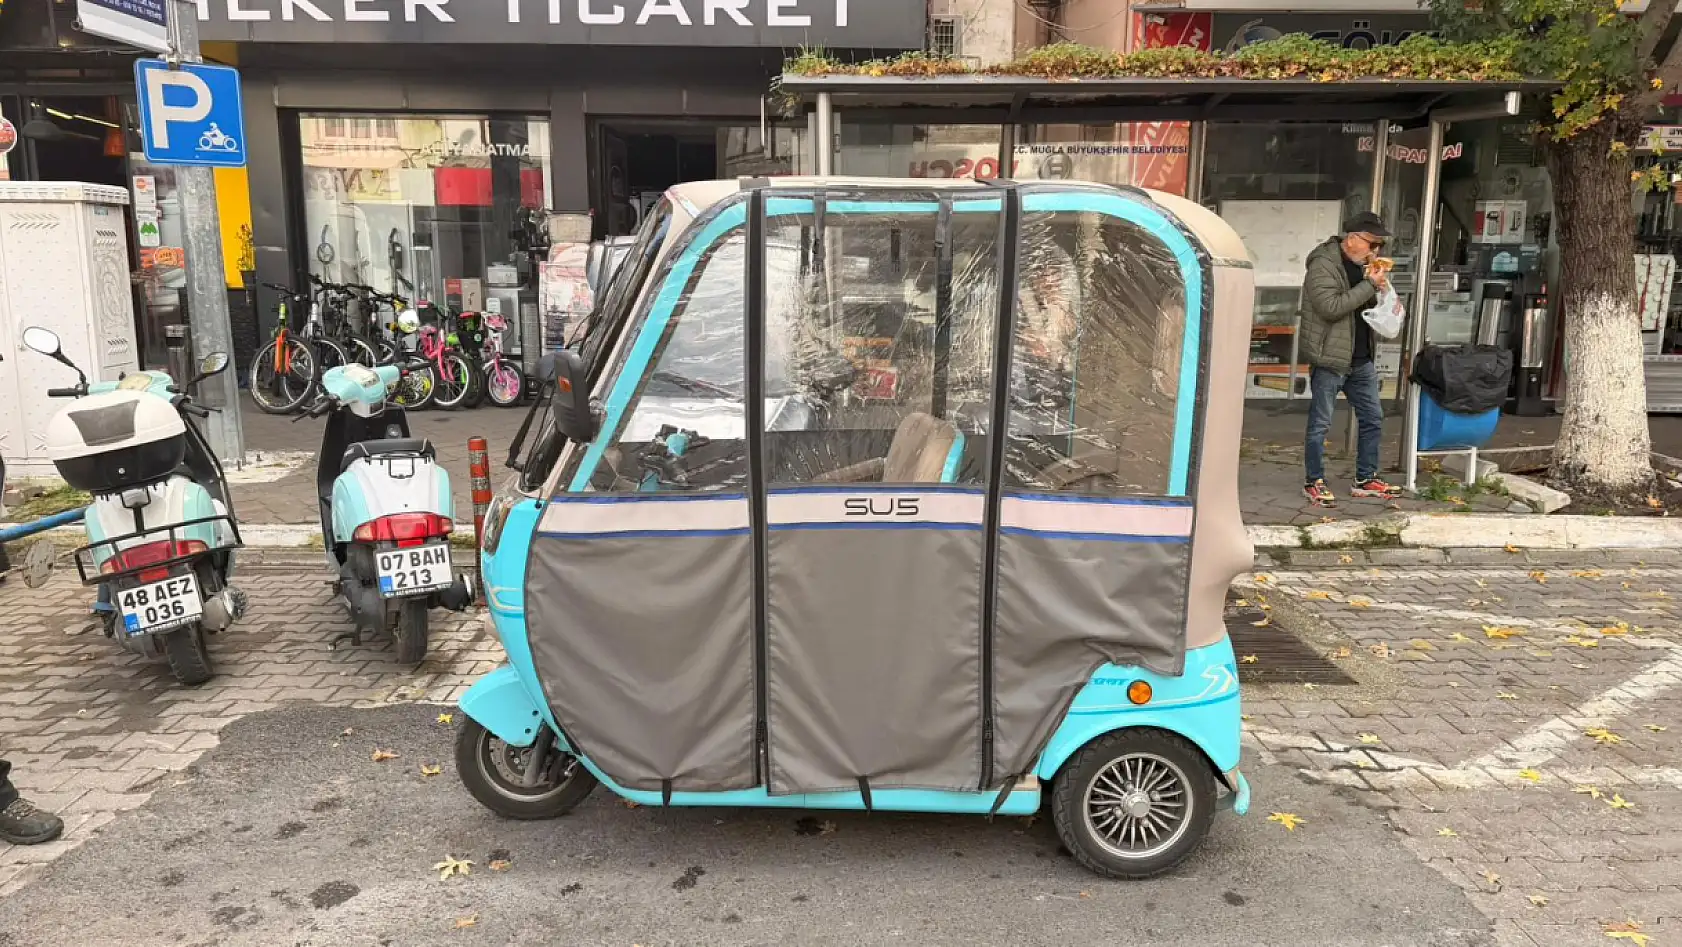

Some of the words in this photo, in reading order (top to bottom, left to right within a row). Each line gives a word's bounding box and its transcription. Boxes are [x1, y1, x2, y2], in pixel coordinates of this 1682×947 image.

[146, 69, 213, 149] P
[1031, 142, 1064, 154] MUĞLA
[1067, 141, 1129, 156] BÜYÜKŞEHİR
[1132, 142, 1188, 154] BELEDİYESİ
[1357, 136, 1463, 164] KMPANA!
[380, 553, 404, 571] 07
[409, 547, 446, 567] BAH
[395, 568, 432, 588] 213
[123, 589, 149, 609] 48
[155, 577, 194, 602] AEZ
[145, 600, 184, 623] 036
